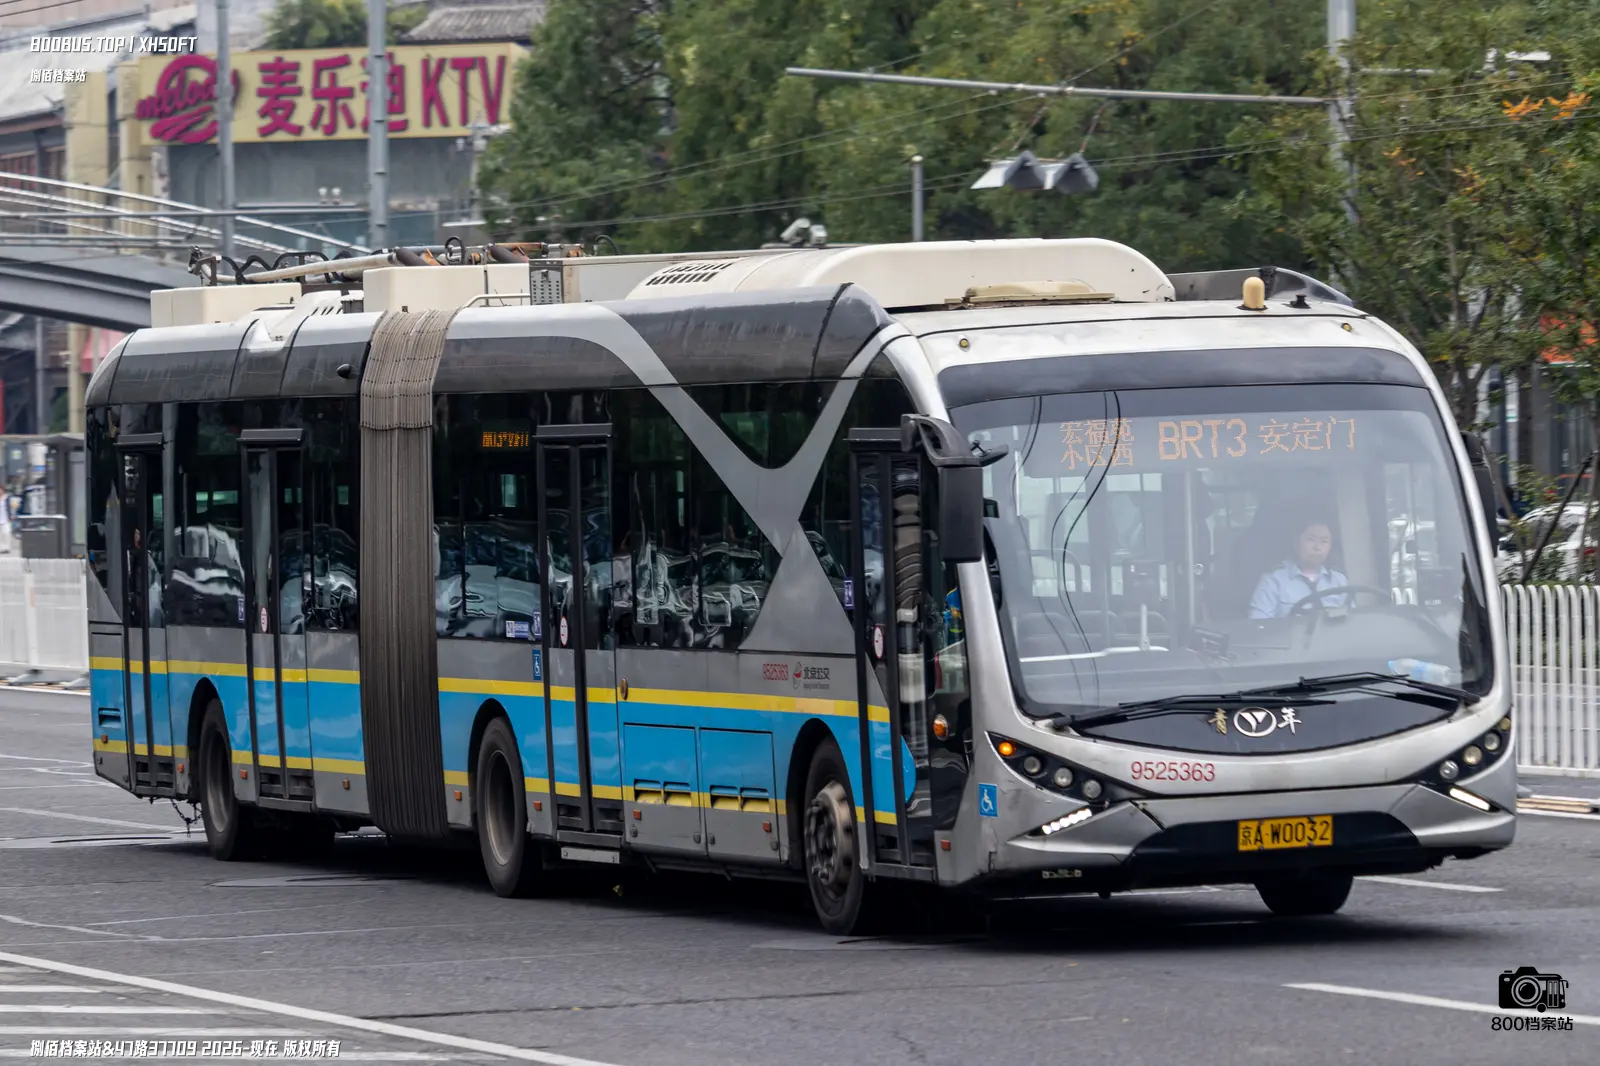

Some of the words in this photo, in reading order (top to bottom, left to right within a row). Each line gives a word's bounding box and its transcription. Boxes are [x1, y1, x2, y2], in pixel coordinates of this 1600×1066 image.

[420, 54, 507, 128] KTV
[1157, 418, 1248, 460] BRT3
[1257, 416, 1356, 454] 安定门
[1277, 707, 1302, 736] 年
[1130, 761, 1216, 782] 9525363
